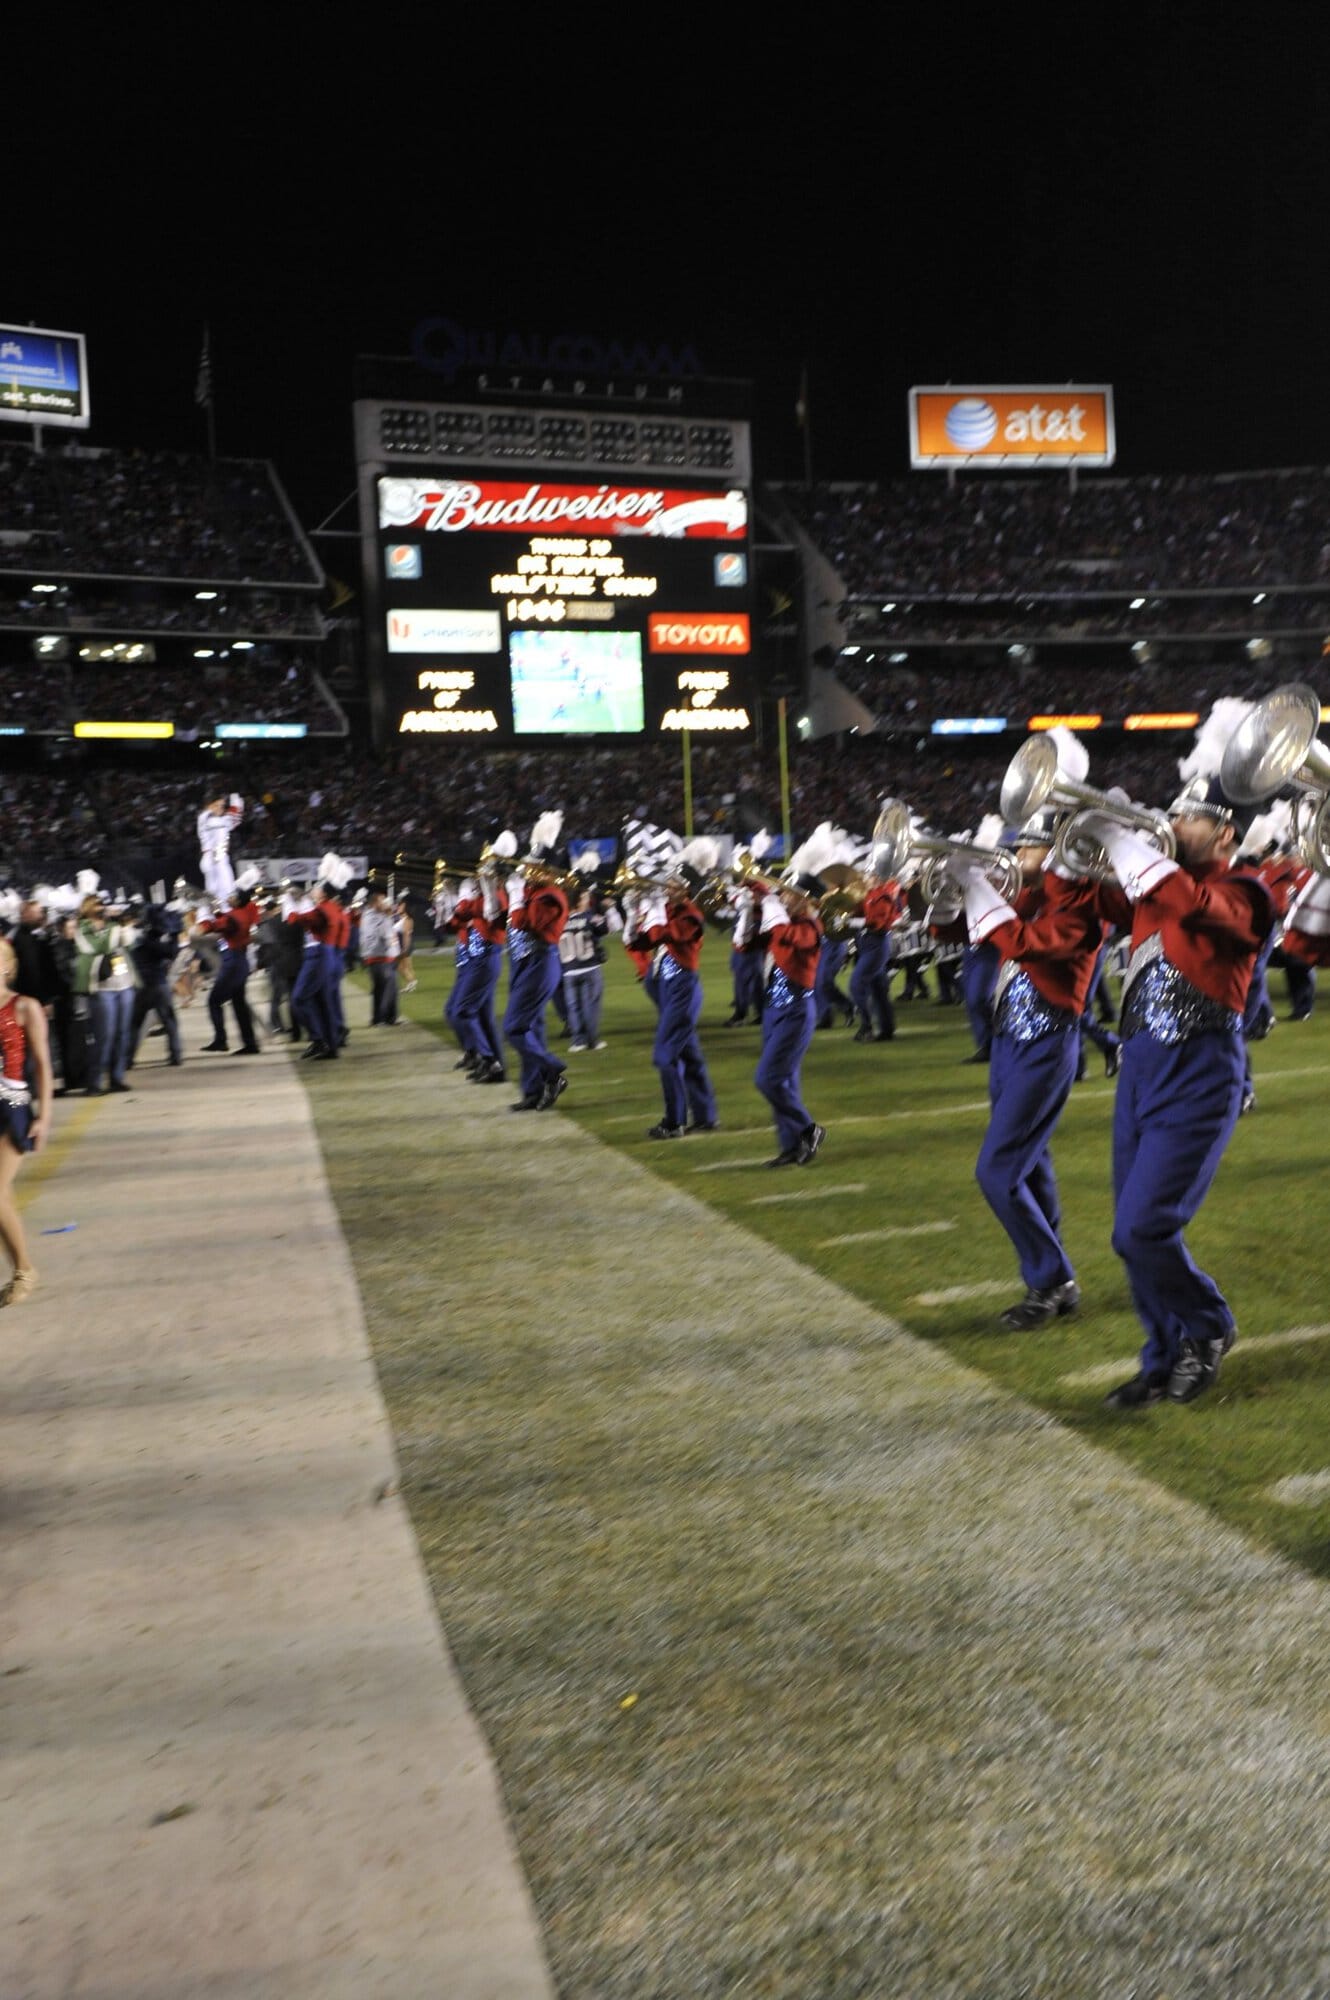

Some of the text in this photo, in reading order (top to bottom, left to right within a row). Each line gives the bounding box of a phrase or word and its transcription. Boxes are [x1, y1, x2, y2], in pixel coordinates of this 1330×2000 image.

[477, 373, 684, 401] STADIUM
[1004, 404, 1087, 442] at&t
[417, 484, 664, 532] Budweiser
[653, 624, 746, 646] TOYOTA
[399, 711, 498, 732] ARIZONA
